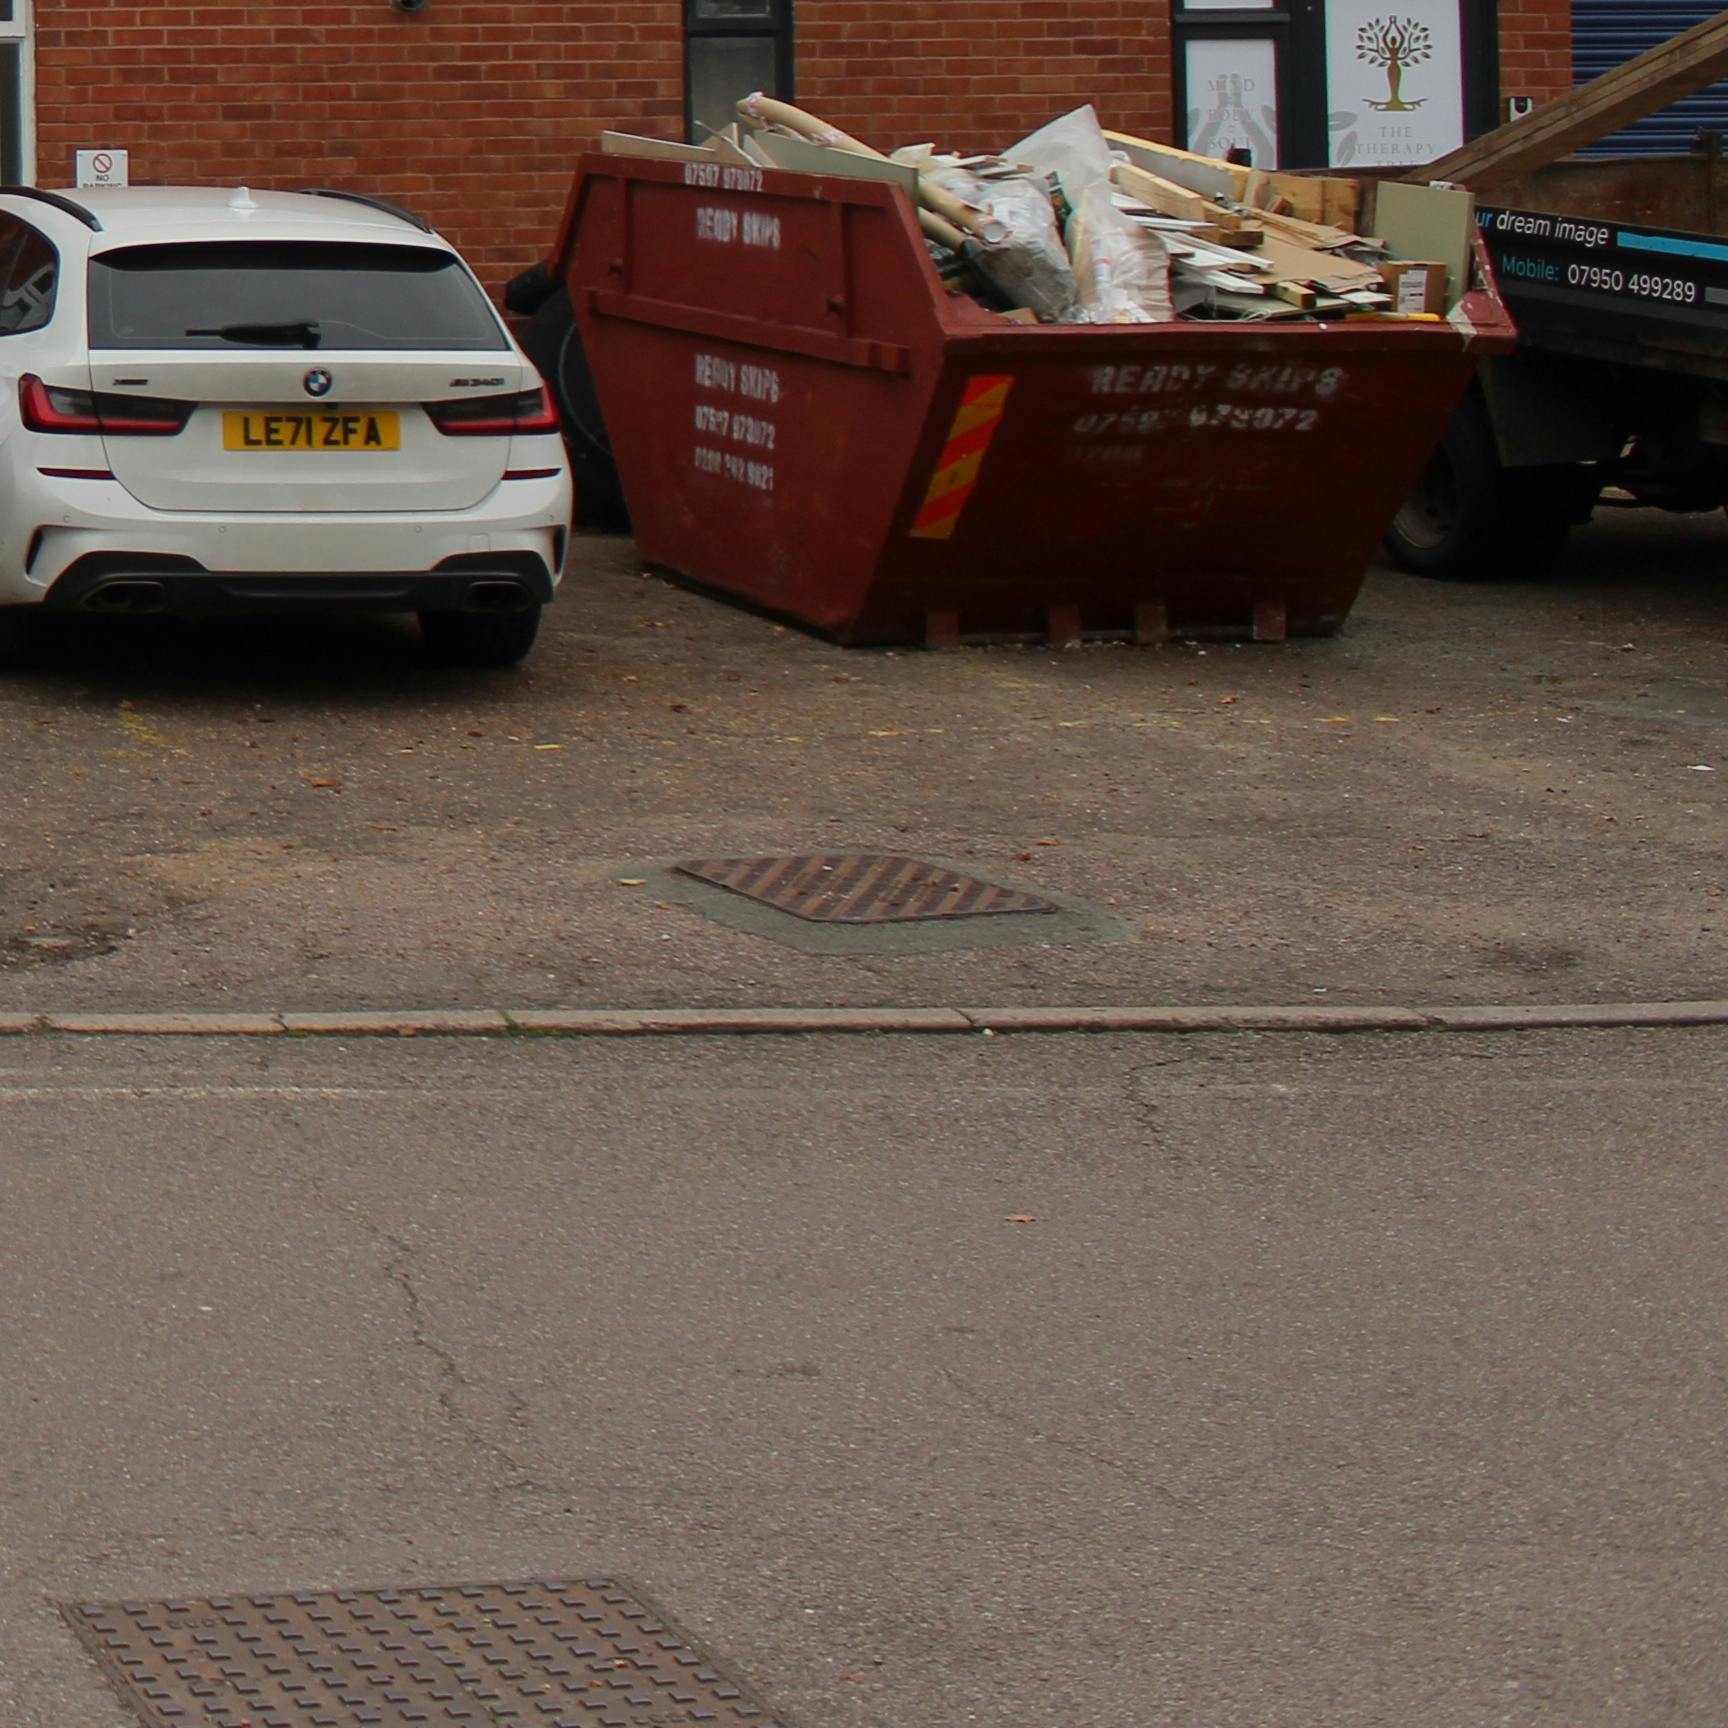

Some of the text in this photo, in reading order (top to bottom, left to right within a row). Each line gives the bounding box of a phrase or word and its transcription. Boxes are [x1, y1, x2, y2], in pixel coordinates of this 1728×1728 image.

[1378, 126, 1413, 138] THE
[1357, 143, 1434, 154] THERAPY
[96, 174, 110, 182] NO
[1475, 210, 1609, 247] ur dream image
[1501, 255, 1695, 303] Mobile: 07950 499289
[244, 416, 381, 447] LE71 ZFA
